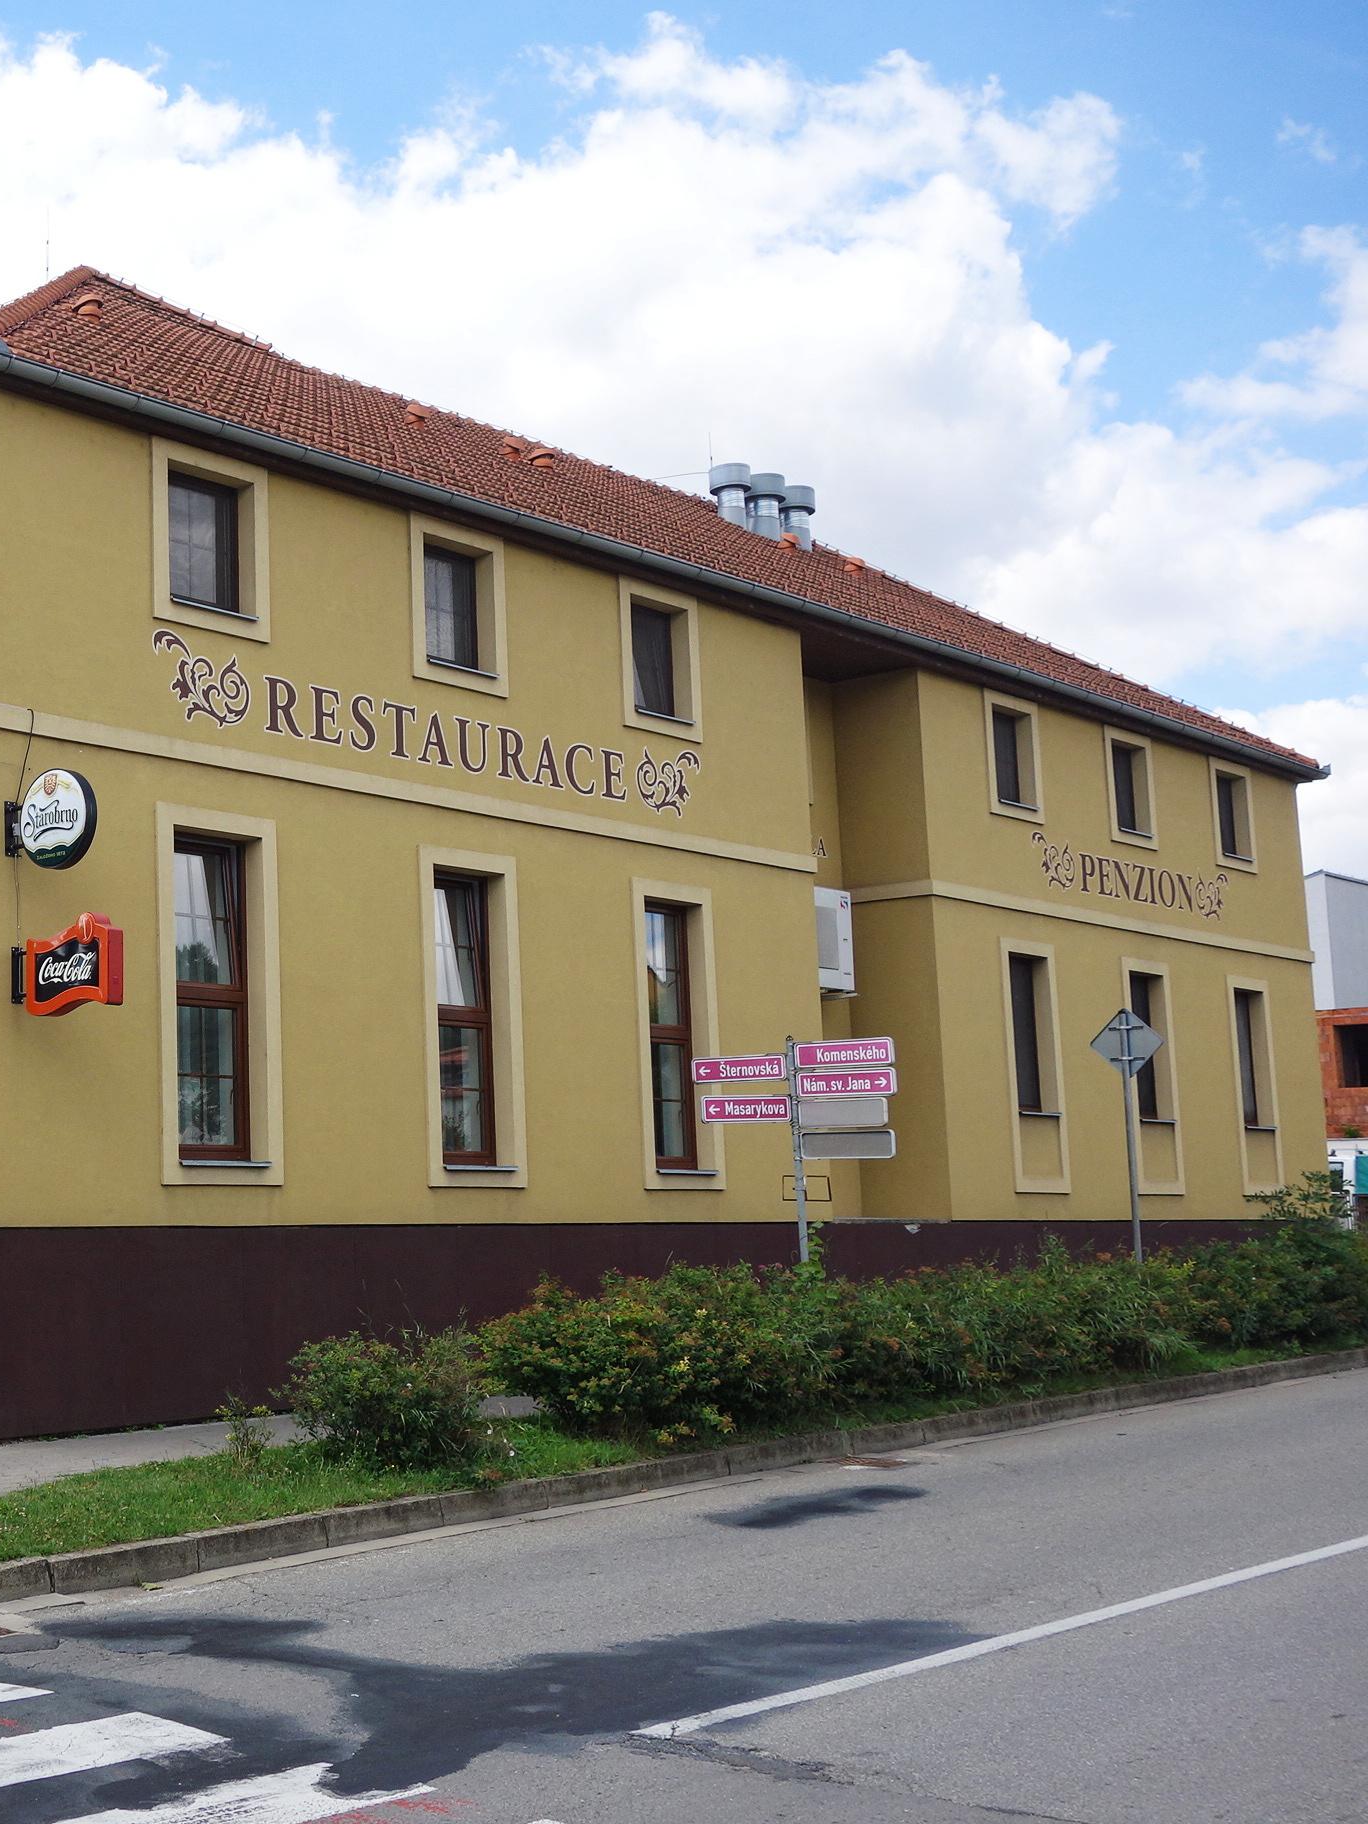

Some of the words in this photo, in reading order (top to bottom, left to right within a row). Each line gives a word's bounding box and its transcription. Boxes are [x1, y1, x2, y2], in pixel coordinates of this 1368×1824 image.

[264, 674, 627, 803] RESTAURACE
[23, 799, 78, 842] Starobrno
[1078, 852, 1193, 913] PENZION
[38, 951, 97, 985] Coca-Cola
[816, 1046, 887, 1063] Komenského
[719, 1061, 779, 1078] Šternovská
[803, 1076, 830, 1092] Nám.
[830, 1078, 845, 1091] sv.
[846, 1075, 871, 1091] Jana
[724, 1100, 785, 1118] Masarykova
